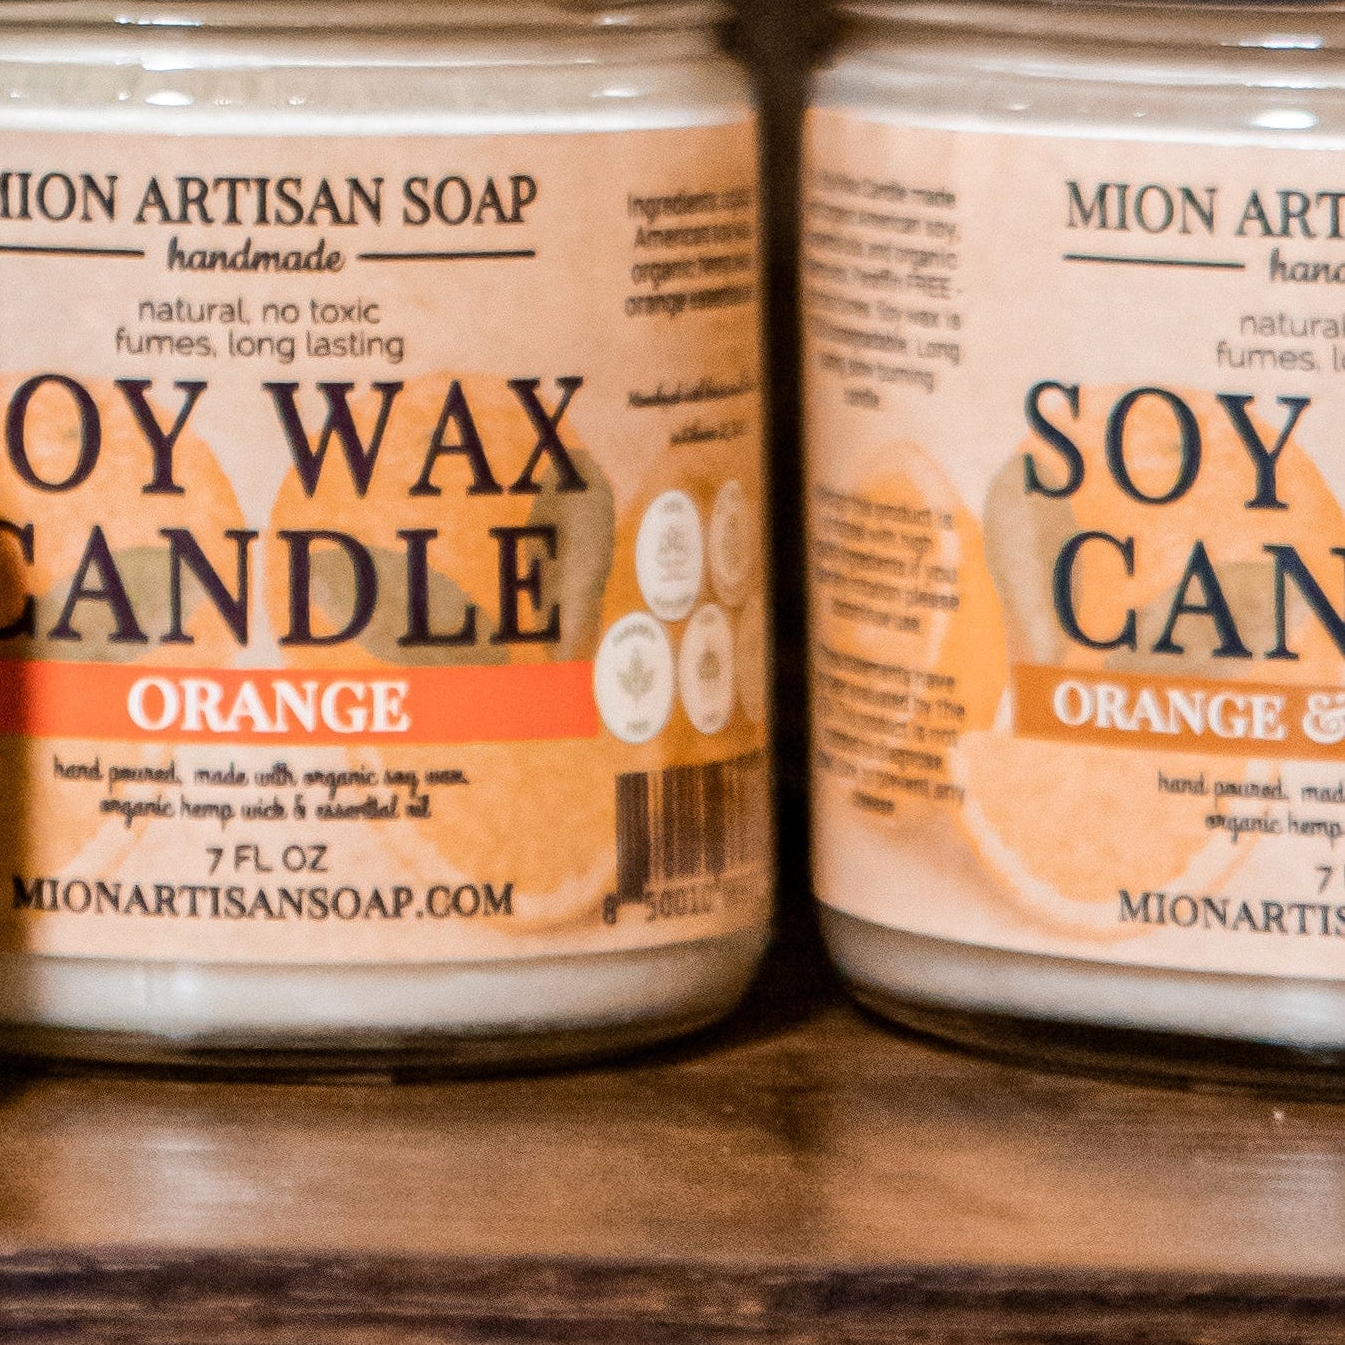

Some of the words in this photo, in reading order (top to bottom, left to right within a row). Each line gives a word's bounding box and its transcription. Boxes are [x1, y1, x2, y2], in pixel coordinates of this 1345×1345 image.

[133, 174, 385, 227] ARTISAN
[402, 174, 538, 226] SOAP
[1064, 180, 1216, 237] MION
[166, 237, 345, 274] handmade
[262, 301, 300, 325] no
[309, 296, 380, 324] toxic
[115, 327, 218, 357] fumes,
[227, 329, 296, 364] long
[305, 329, 405, 364] lasting
[261, 374, 588, 498] WAX
[1023, 379, 1311, 510] SOY
[1052, 530, 1345, 662] CAN
[127, 676, 412, 735] ORANGE
[1053, 679, 1286, 741] ORANGE
[53, 755, 102, 782] hand
[1158, 770, 1207, 797] hand
[99, 796, 173, 830] organic
[179, 793, 236, 831] hemp
[1205, 813, 1280, 846] organic
[1287, 809, 1342, 851] hemp
[205, 846, 224, 876] 7
[234, 844, 273, 873] FL
[282, 843, 329, 873] OZ
[1314, 865, 1333, 894] 7
[12, 877, 515, 921] MIONARTISANSOAP.COM
